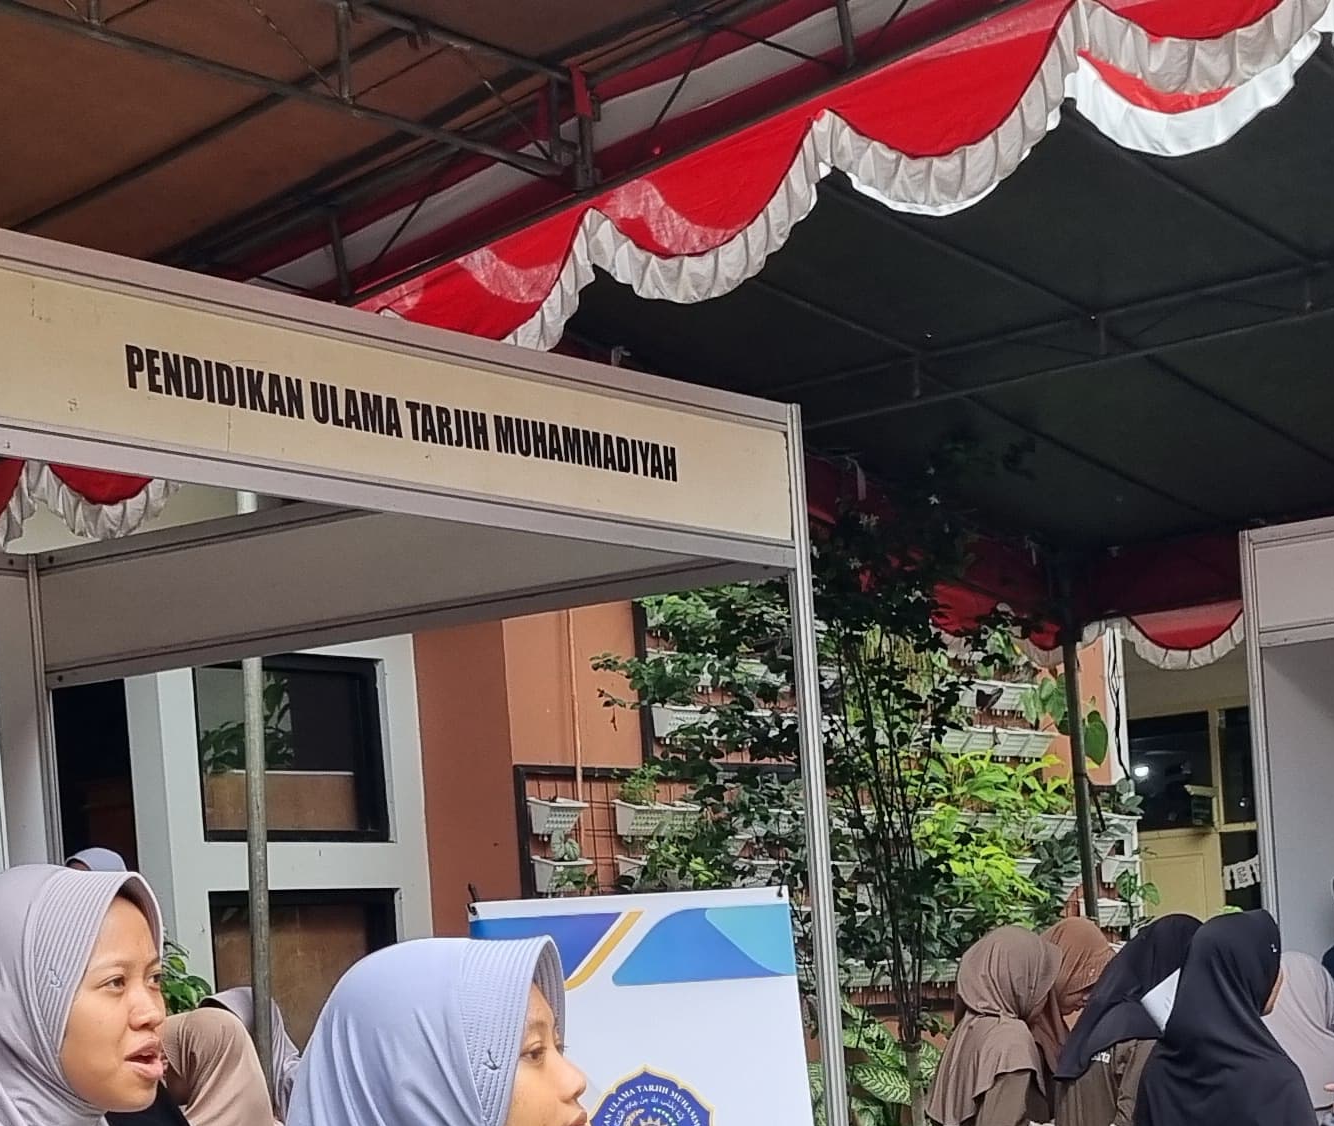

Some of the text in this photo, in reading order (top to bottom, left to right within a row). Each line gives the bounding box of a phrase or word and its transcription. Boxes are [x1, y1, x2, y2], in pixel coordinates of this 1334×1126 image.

[125, 344, 678, 483] PENDIDIKAN ULAMA TARJIH MUHAMMADIYAH
